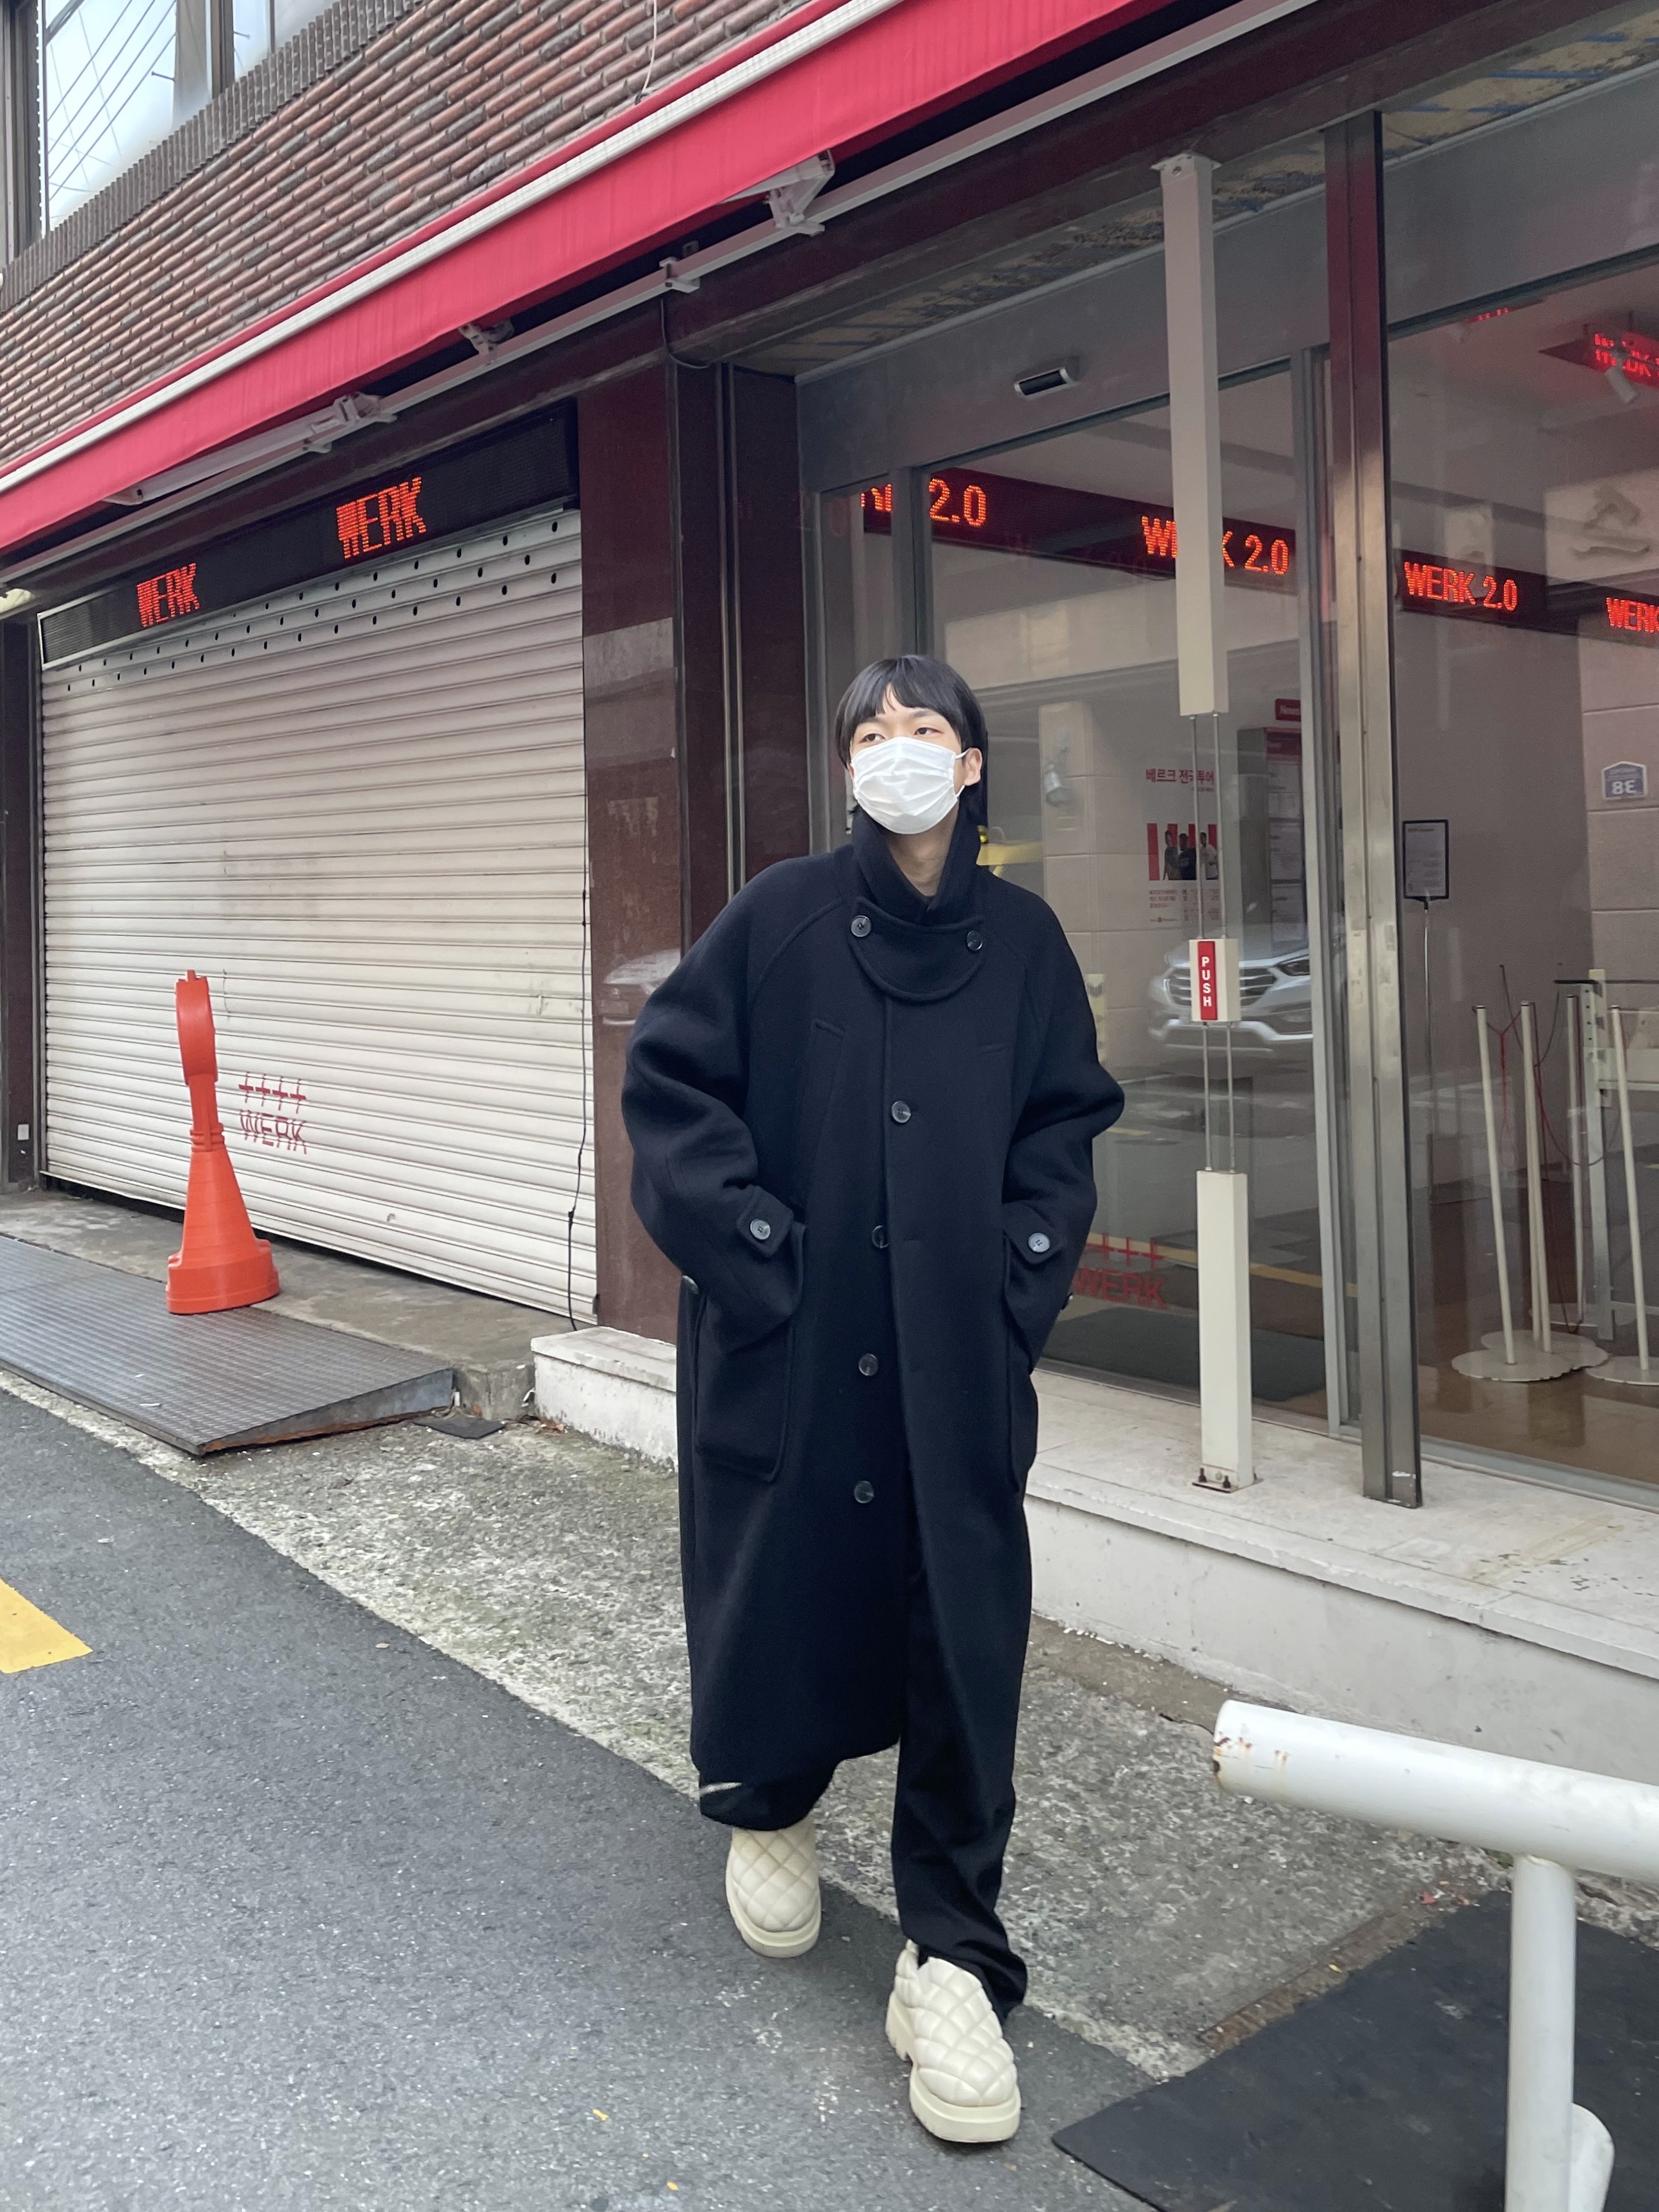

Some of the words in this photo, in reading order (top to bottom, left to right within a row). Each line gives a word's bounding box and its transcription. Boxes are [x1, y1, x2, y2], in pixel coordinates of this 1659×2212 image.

[336, 476, 427, 559] WERK
[929, 478, 986, 527] 2.0
[1245, 534, 1289, 574] 2.0
[136, 563, 200, 628] WERK
[1404, 561, 1475, 605] WERK
[1483, 575, 1518, 612] 2.0
[1145, 768, 1177, 782] 베르크
[1201, 956, 1212, 1007] PUSH
[240, 1109, 307, 1154] WERK
[1074, 1266, 1168, 1311] WERK
